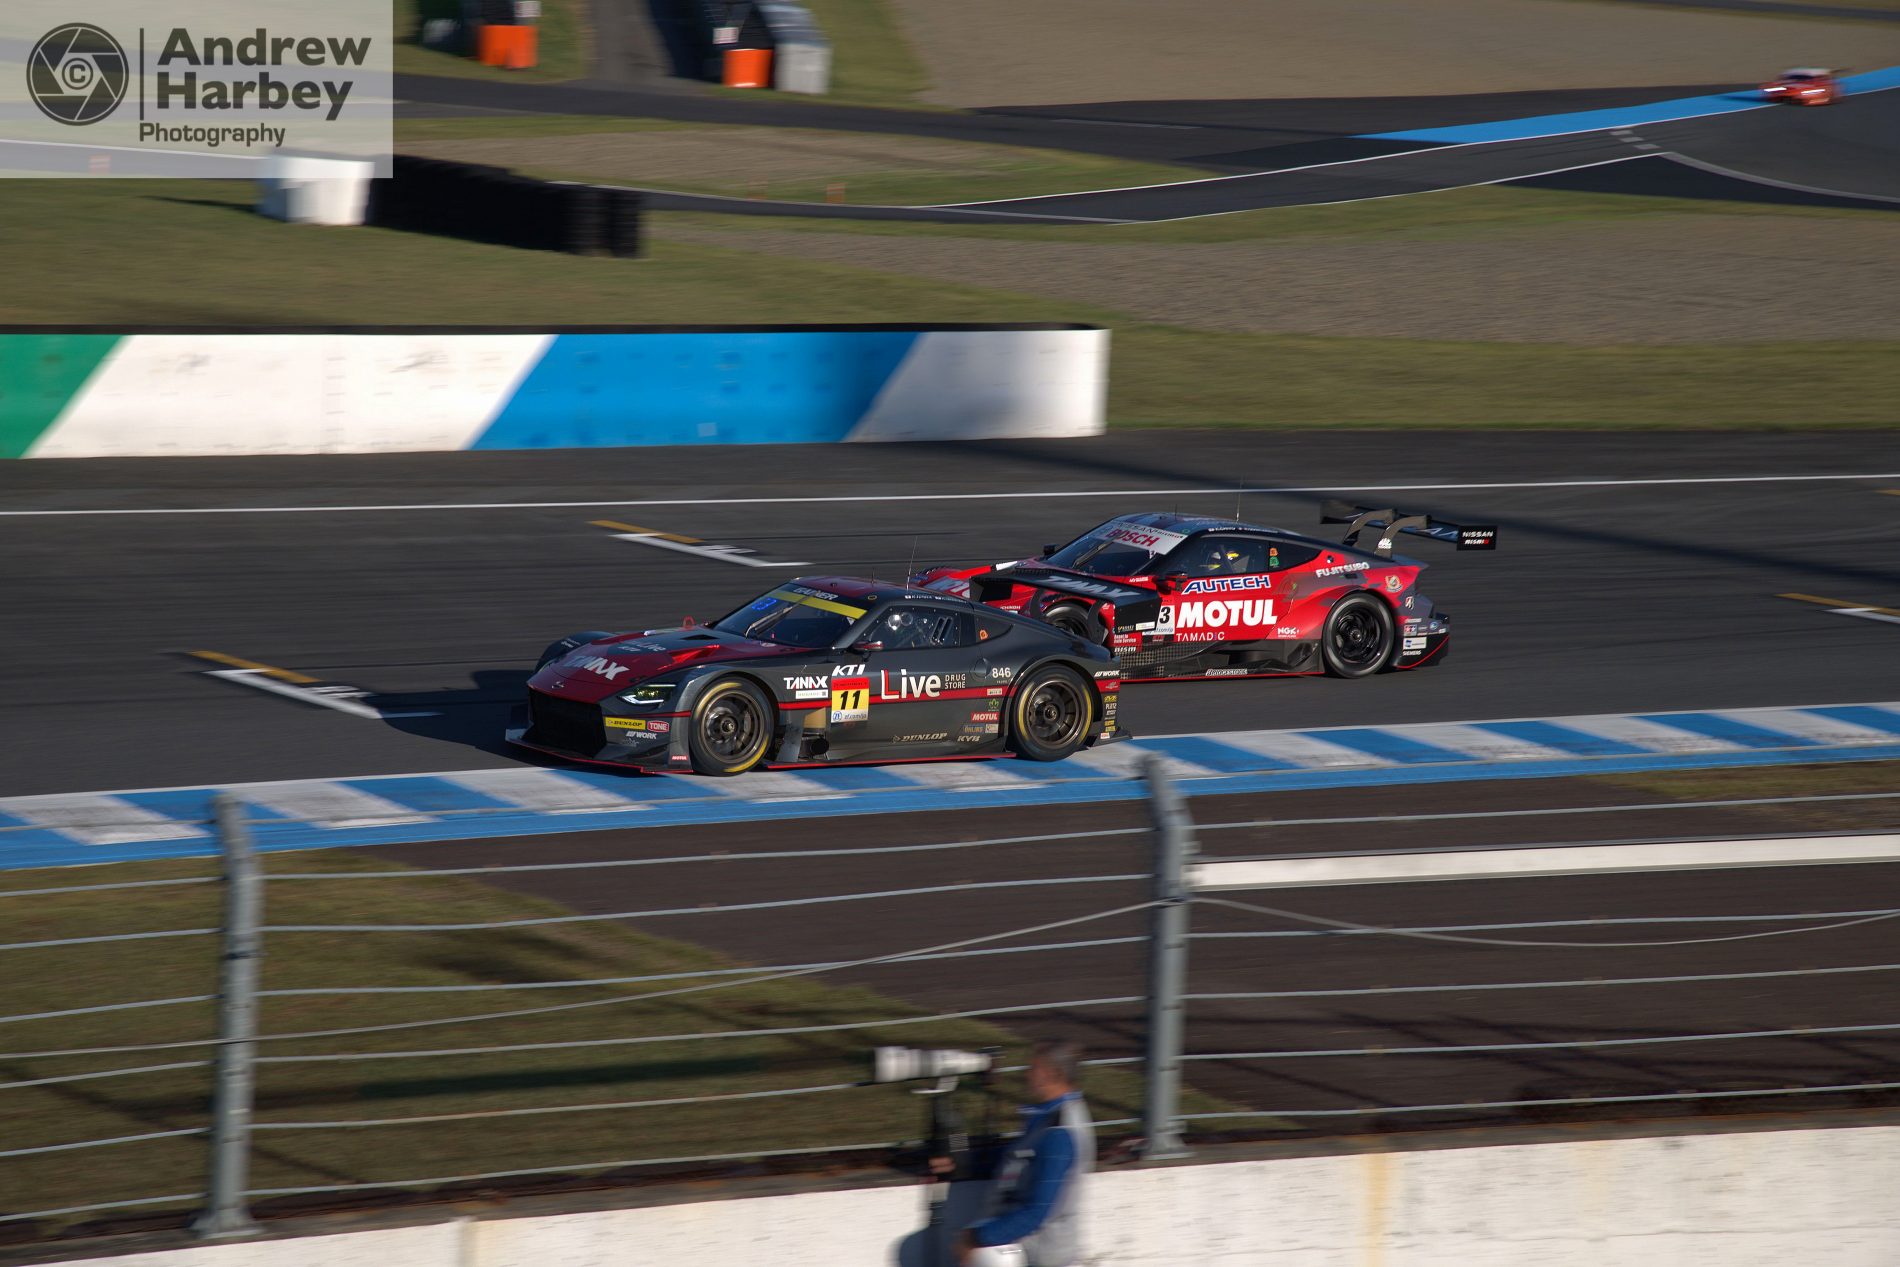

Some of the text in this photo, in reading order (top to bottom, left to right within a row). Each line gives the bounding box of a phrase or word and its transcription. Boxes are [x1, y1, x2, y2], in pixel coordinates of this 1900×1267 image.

[1105, 529, 1160, 547] BOSCH
[1316, 562, 1370, 578] FUJITSUBO
[1181, 575, 1272, 596] AUTECH
[1159, 606, 1171, 624] 3
[1176, 599, 1278, 628] MOTUL
[1278, 627, 1297, 635] NGK
[832, 664, 866, 676] KTI
[992, 667, 1011, 678] 846
[783, 676, 828, 690] TANAX
[944, 673, 966, 681] DRUG
[880, 669, 942, 700] Live
[944, 681, 966, 690] STORE
[840, 690, 861, 710] 11
[972, 713, 998, 721] MOTUL
[649, 722, 668, 731] TONE
[901, 732, 948, 742] DUNLOP
